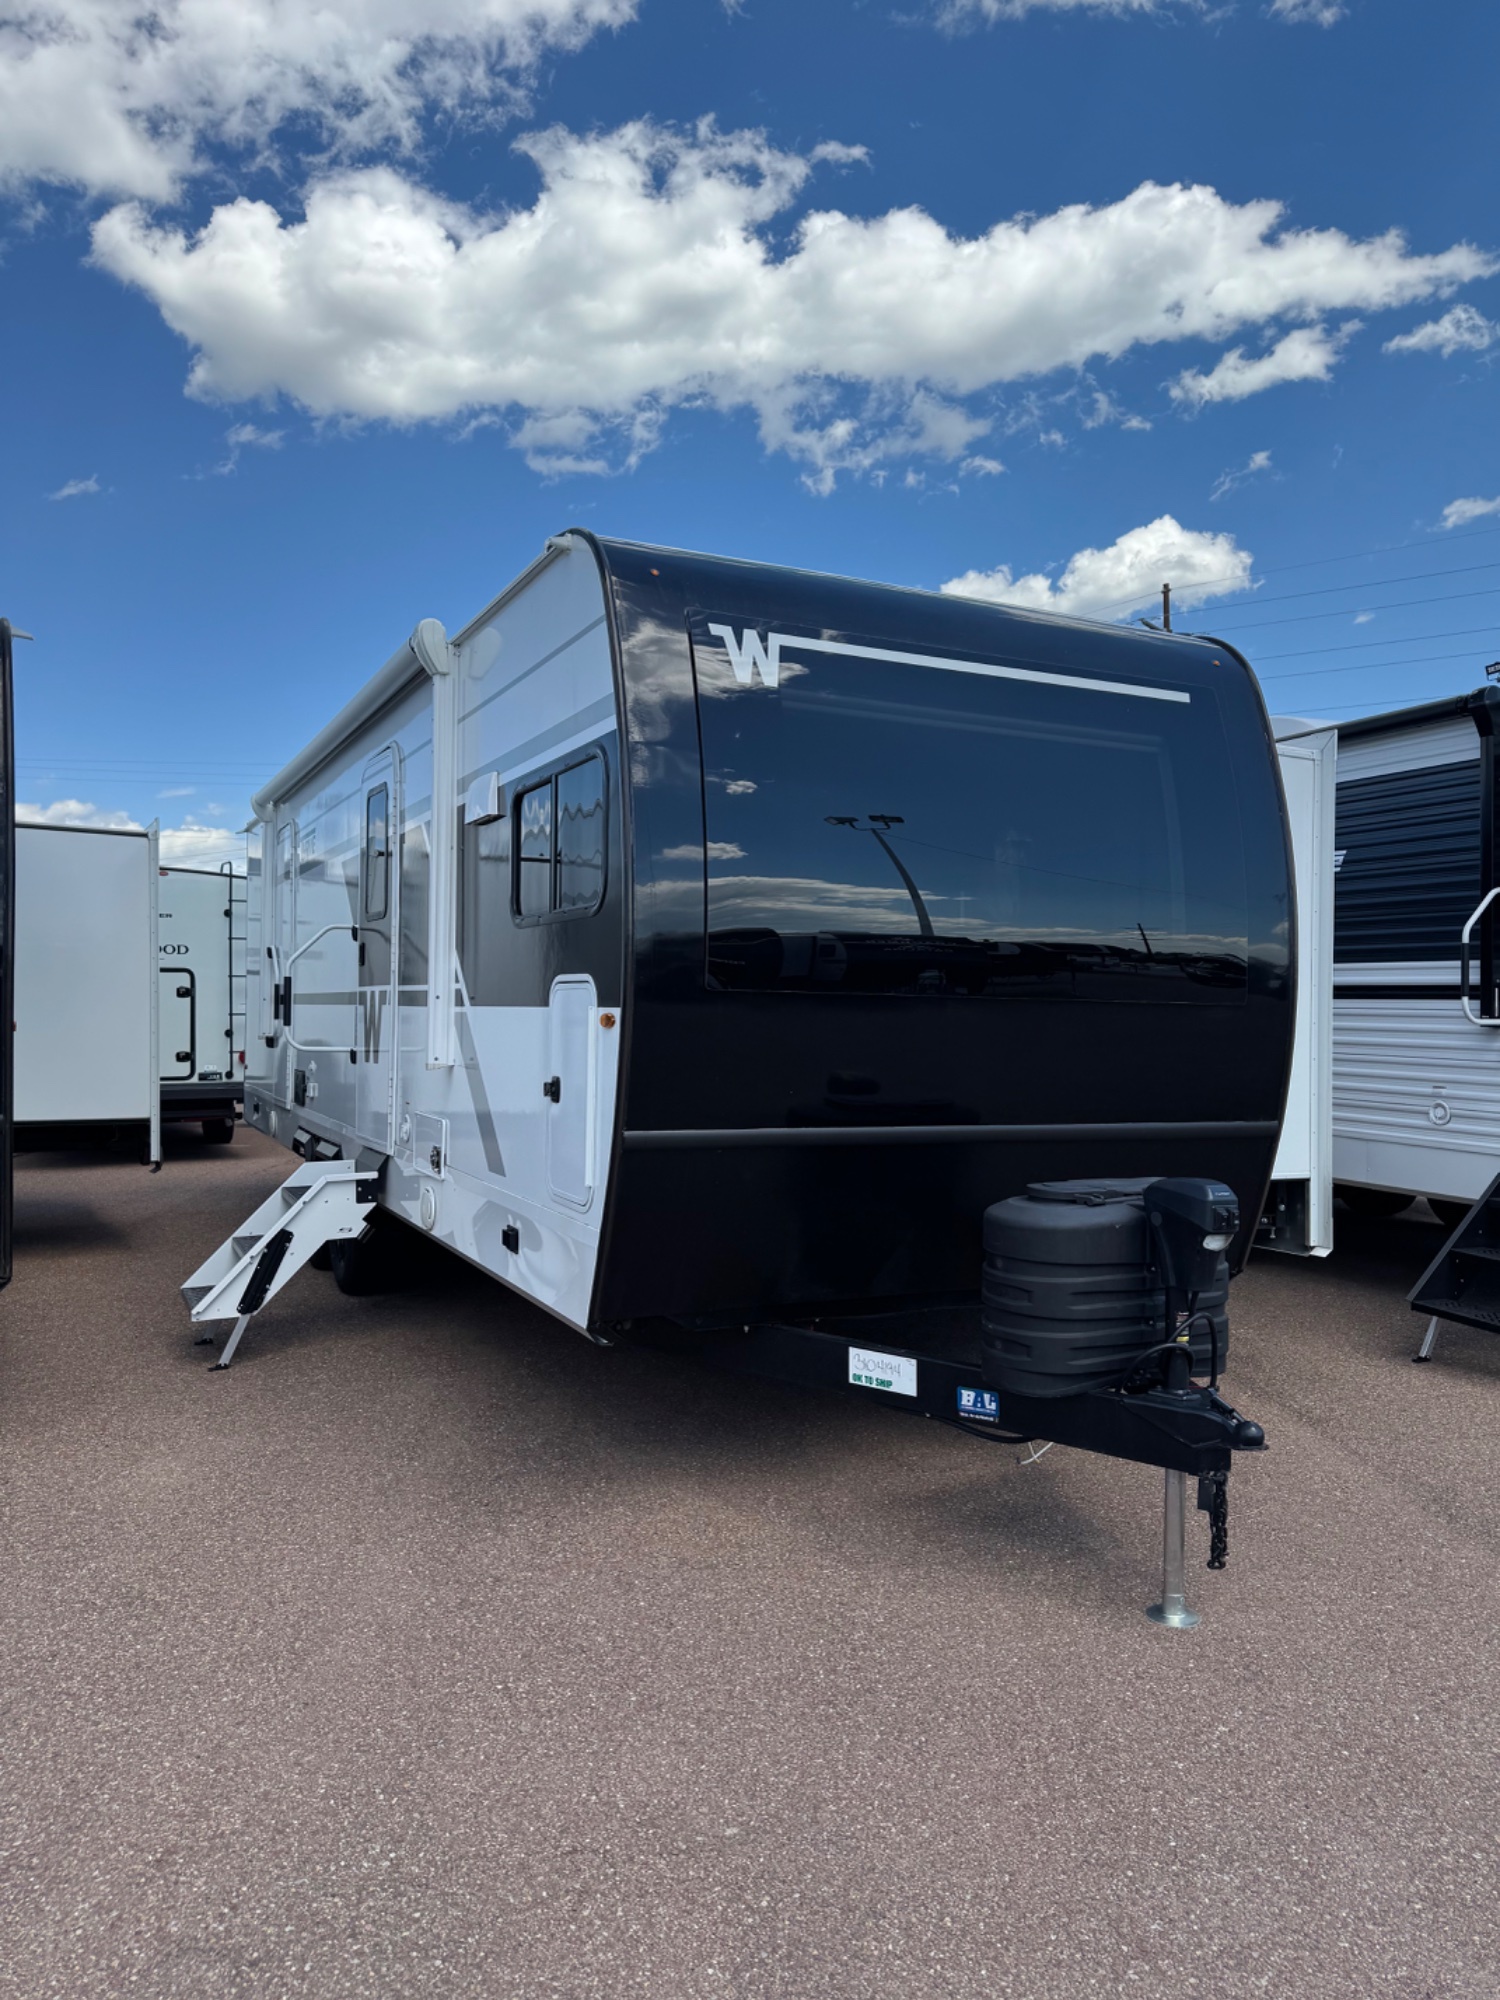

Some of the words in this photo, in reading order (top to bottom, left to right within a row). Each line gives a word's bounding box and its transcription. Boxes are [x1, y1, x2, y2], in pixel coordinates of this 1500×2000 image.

[708, 622, 780, 688] W
[159, 944, 189, 955] OD
[852, 1373, 863, 1383] OK
[864, 1375, 874, 1385] TO
[875, 1377, 893, 1389] SHIP
